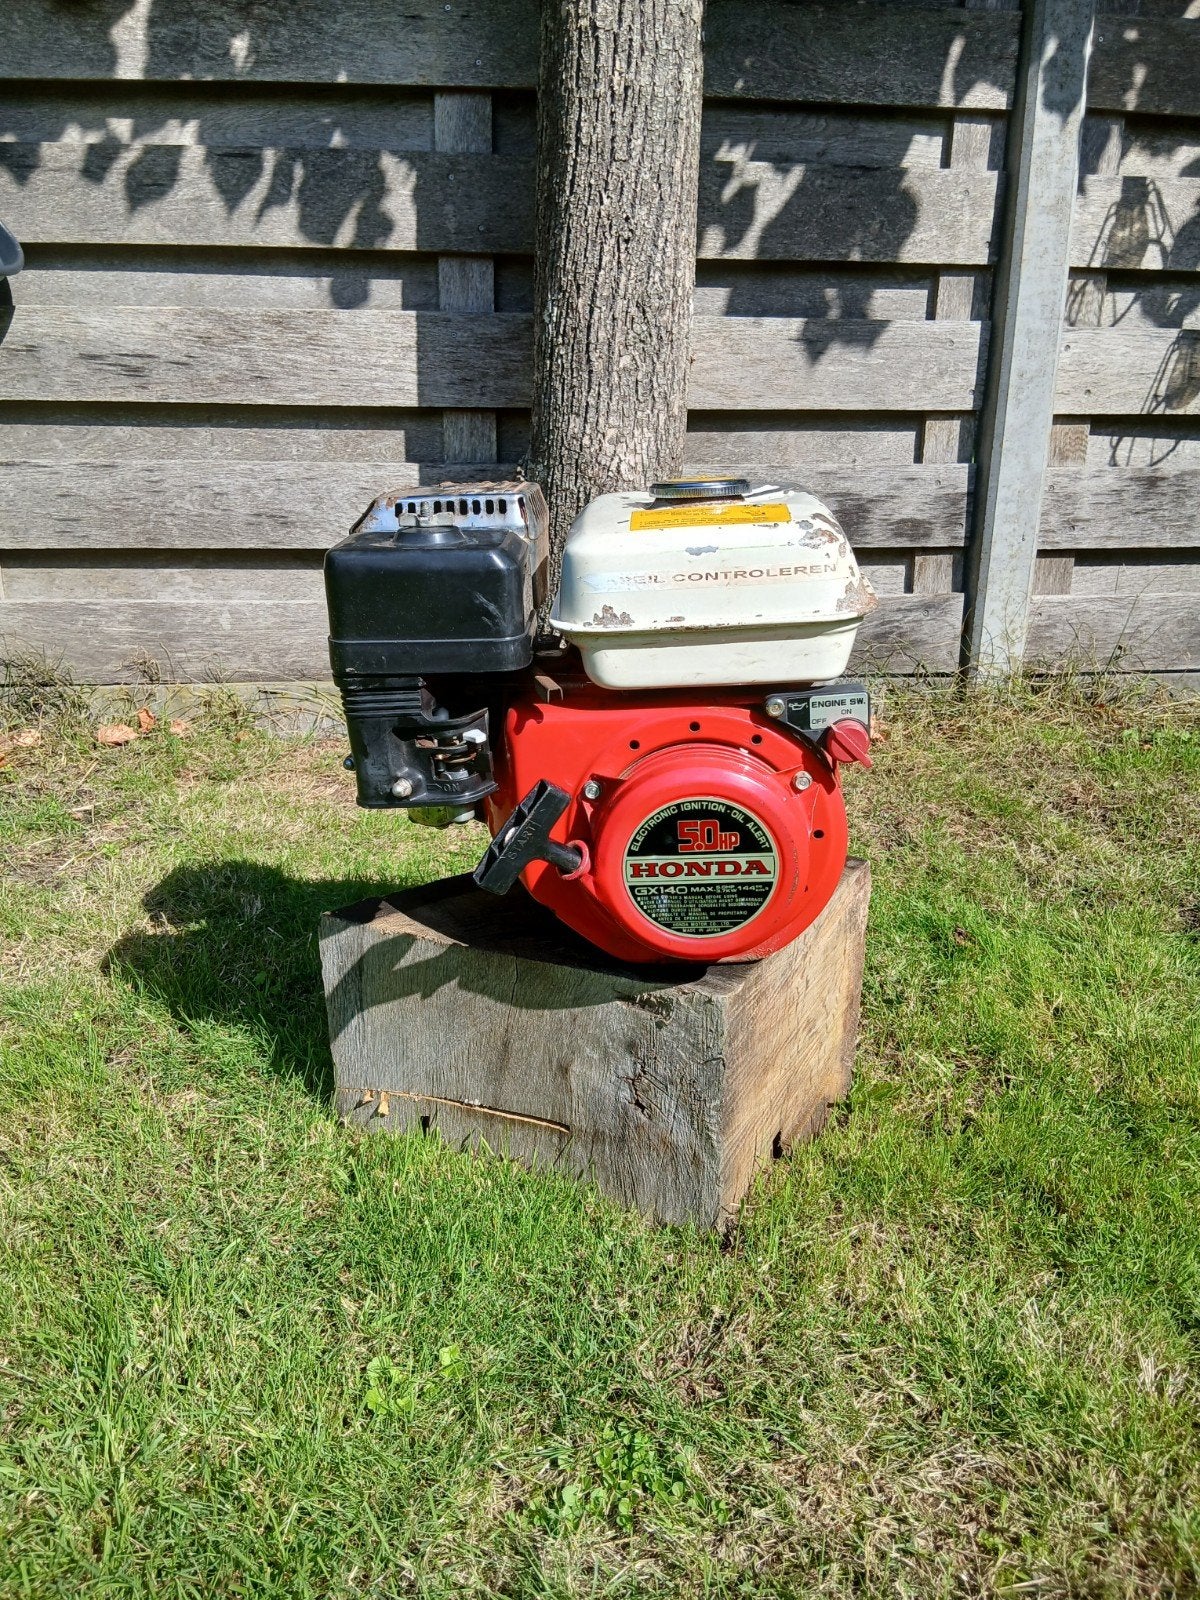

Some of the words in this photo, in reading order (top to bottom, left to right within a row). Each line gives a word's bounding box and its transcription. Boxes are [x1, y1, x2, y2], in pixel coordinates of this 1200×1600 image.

[672, 563, 837, 583] CONTROLEREN
[811, 698, 847, 709] ENGINE
[849, 697, 866, 706] SW.
[811, 717, 827, 725] OFF
[630, 805, 678, 852] ELECTRONIC
[680, 801, 726, 813] IGNITION
[730, 809, 745, 824] OIL
[746, 821, 770, 849] ALERT
[629, 859, 772, 879] HONDA
[634, 885, 688, 896] GX140
